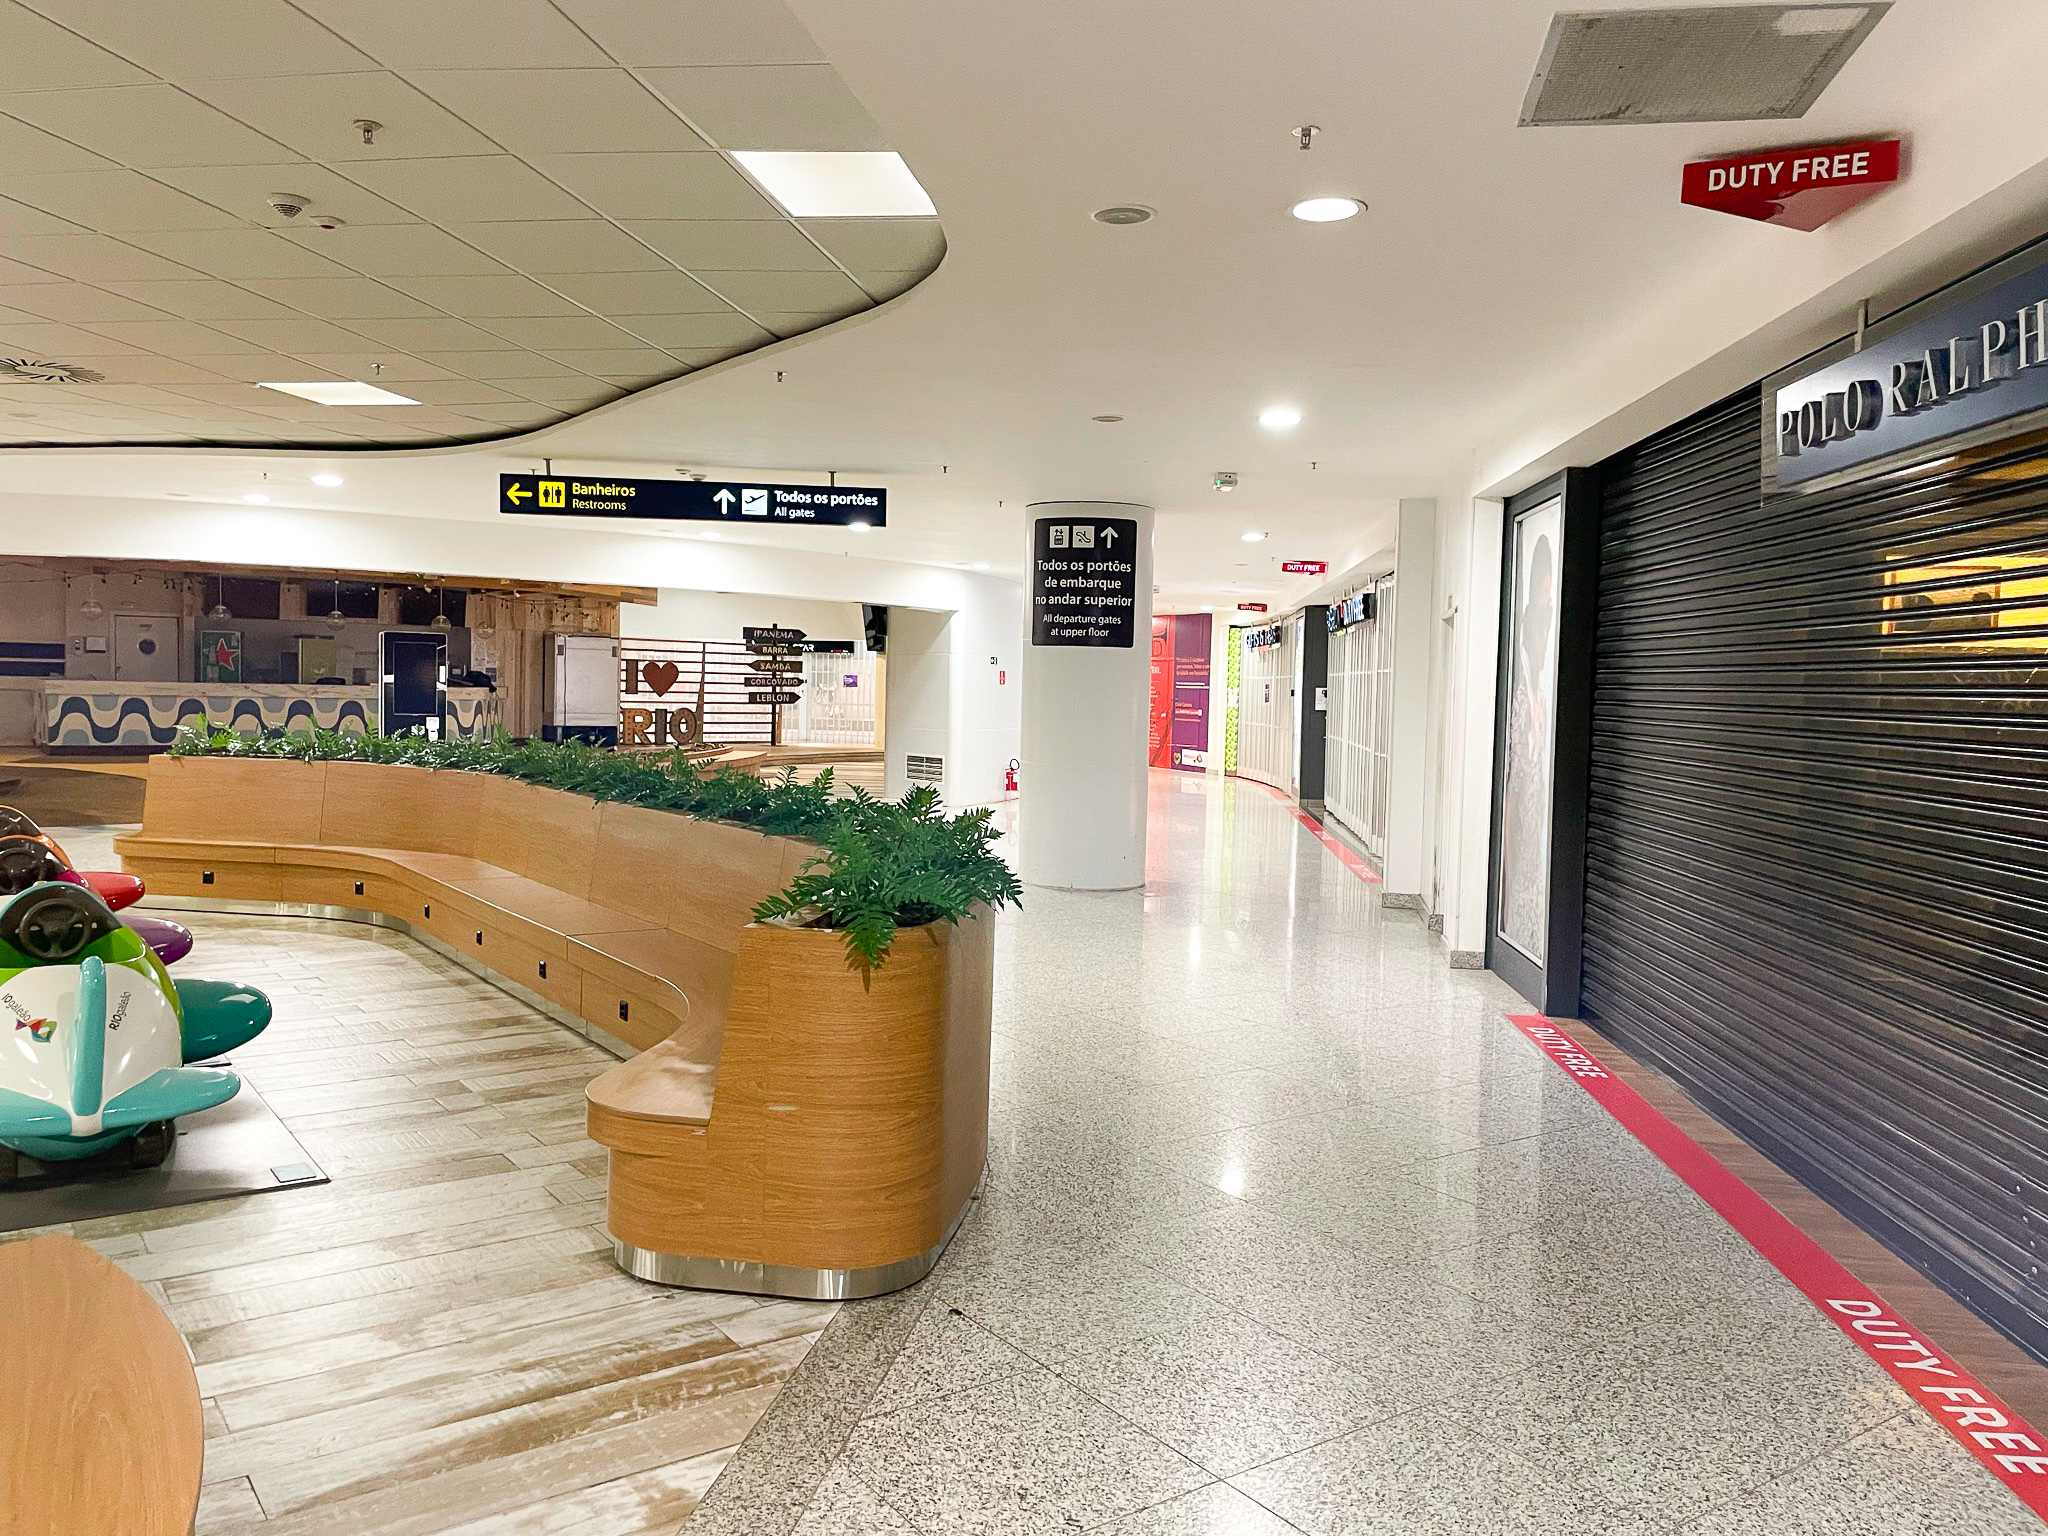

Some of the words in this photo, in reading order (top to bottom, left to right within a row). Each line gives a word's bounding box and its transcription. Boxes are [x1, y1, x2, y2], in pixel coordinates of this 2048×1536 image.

[1708, 161, 1784, 191] DUTY
[1792, 151, 1870, 182] FREE
[1779, 380, 1878, 456] POLO
[1889, 299, 2048, 416] RALPH
[572, 482, 636, 498] Banheiros
[572, 498, 627, 512] Restrooms
[774, 490, 812, 504] Todos
[814, 494, 829, 505] os
[831, 492, 879, 508] portões
[774, 507, 788, 518] All
[789, 508, 816, 521] gates
[1037, 559, 1068, 571] Todos
[1070, 561, 1084, 571] os
[1087, 560, 1132, 573] portões
[1287, 563, 1304, 572] DUTY
[1304, 564, 1321, 573] FREE
[1044, 576, 1058, 588] de
[1060, 576, 1122, 591] embarque
[1035, 595, 1047, 605] no
[1048, 593, 1081, 605] andar
[1084, 595, 1133, 608] superior
[1042, 614, 1052, 623] All
[1053, 614, 1097, 625] departure
[1098, 615, 1122, 626] gates
[753, 629, 794, 640] IPANEMA
[1050, 627, 1059, 636] at
[1060, 628, 1087, 638] upper
[1088, 627, 1110, 637] floor
[762, 646, 789, 655] BARRA
[760, 662, 792, 671] SAMBA
[625, 659, 639, 694] I
[750, 678, 798, 687] CORCOVADO
[756, 693, 790, 703] LEBLON
[622, 707, 698, 745] RIO
[108, 991, 132, 1031] RIOgaleão
[1526, 1026, 1579, 1052] DUTY
[1554, 1052, 1609, 1078] FREE
[1825, 1299, 1958, 1378] DUTY
[1920, 1386, 2048, 1474] FREE
